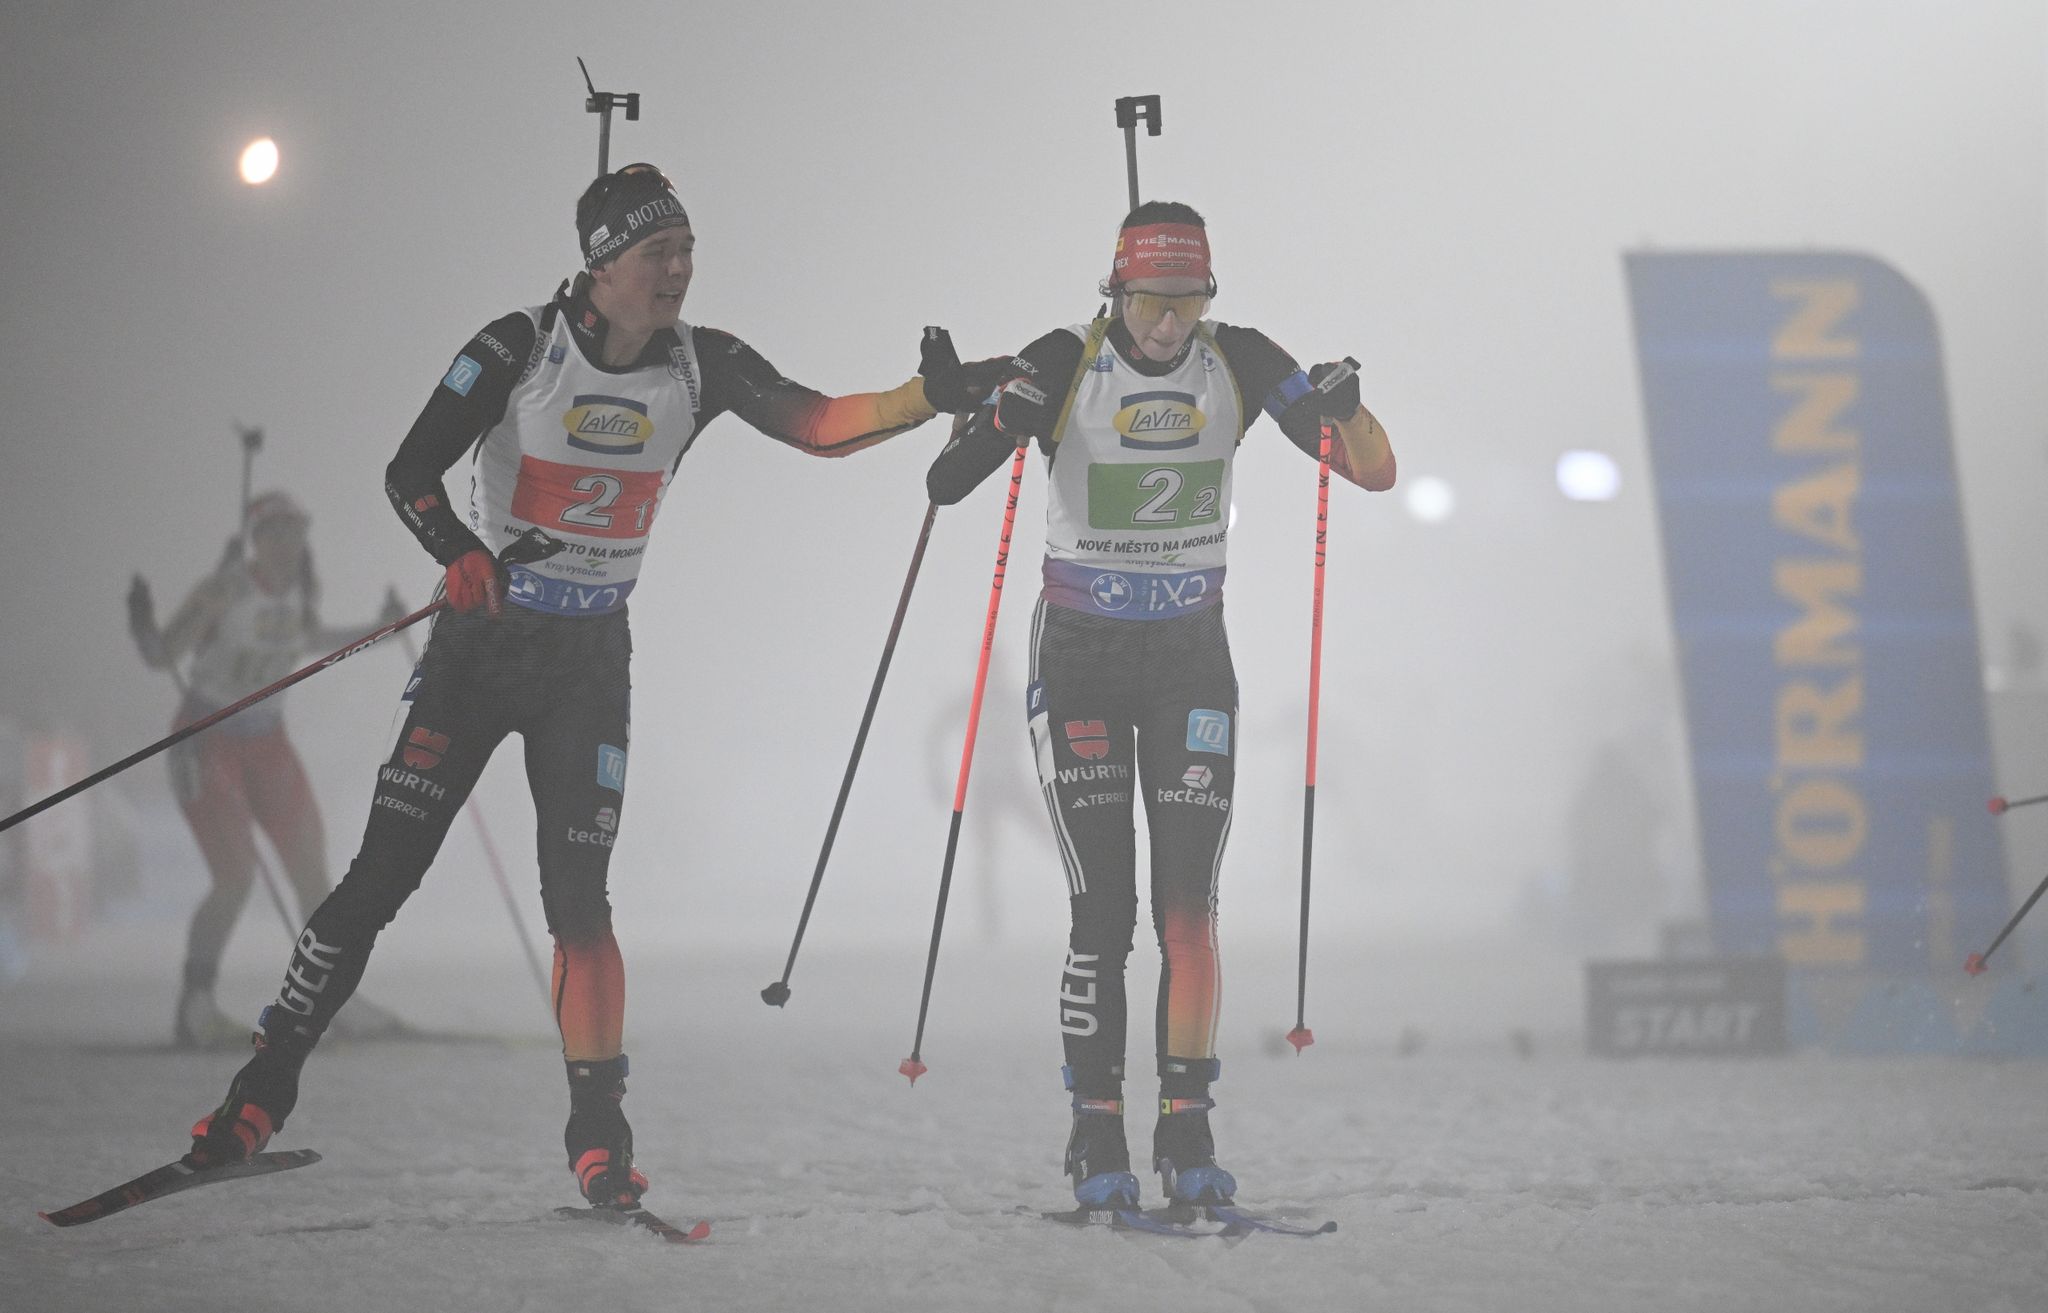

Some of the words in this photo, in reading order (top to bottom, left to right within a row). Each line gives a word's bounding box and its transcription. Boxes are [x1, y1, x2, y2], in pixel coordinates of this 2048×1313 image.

[590, 231, 629, 259] TERREX
[477, 332, 516, 366] TERREX
[675, 349, 698, 409] robotron
[559, 474, 623, 529] 2
[634, 498, 651, 531] 1
[1131, 467, 1184, 525] 2
[1188, 486, 1218, 522] 2
[588, 546, 607, 559] NA
[1075, 539, 1111, 553] NOVÉ
[1114, 540, 1159, 554] MĚSTO
[1162, 541, 1179, 553] NA
[1770, 275, 1871, 969] HÖRMANN
[381, 767, 446, 801] WÜRTH
[1058, 763, 1128, 785] WÜRTH
[383, 796, 430, 822] TERREX
[1088, 791, 1129, 807] TERREX
[1157, 788, 1229, 812] tectake
[568, 827, 615, 848] tecta
[279, 927, 342, 1017] GER
[1061, 947, 1100, 1037] GER
[1613, 1003, 1761, 1047] START
